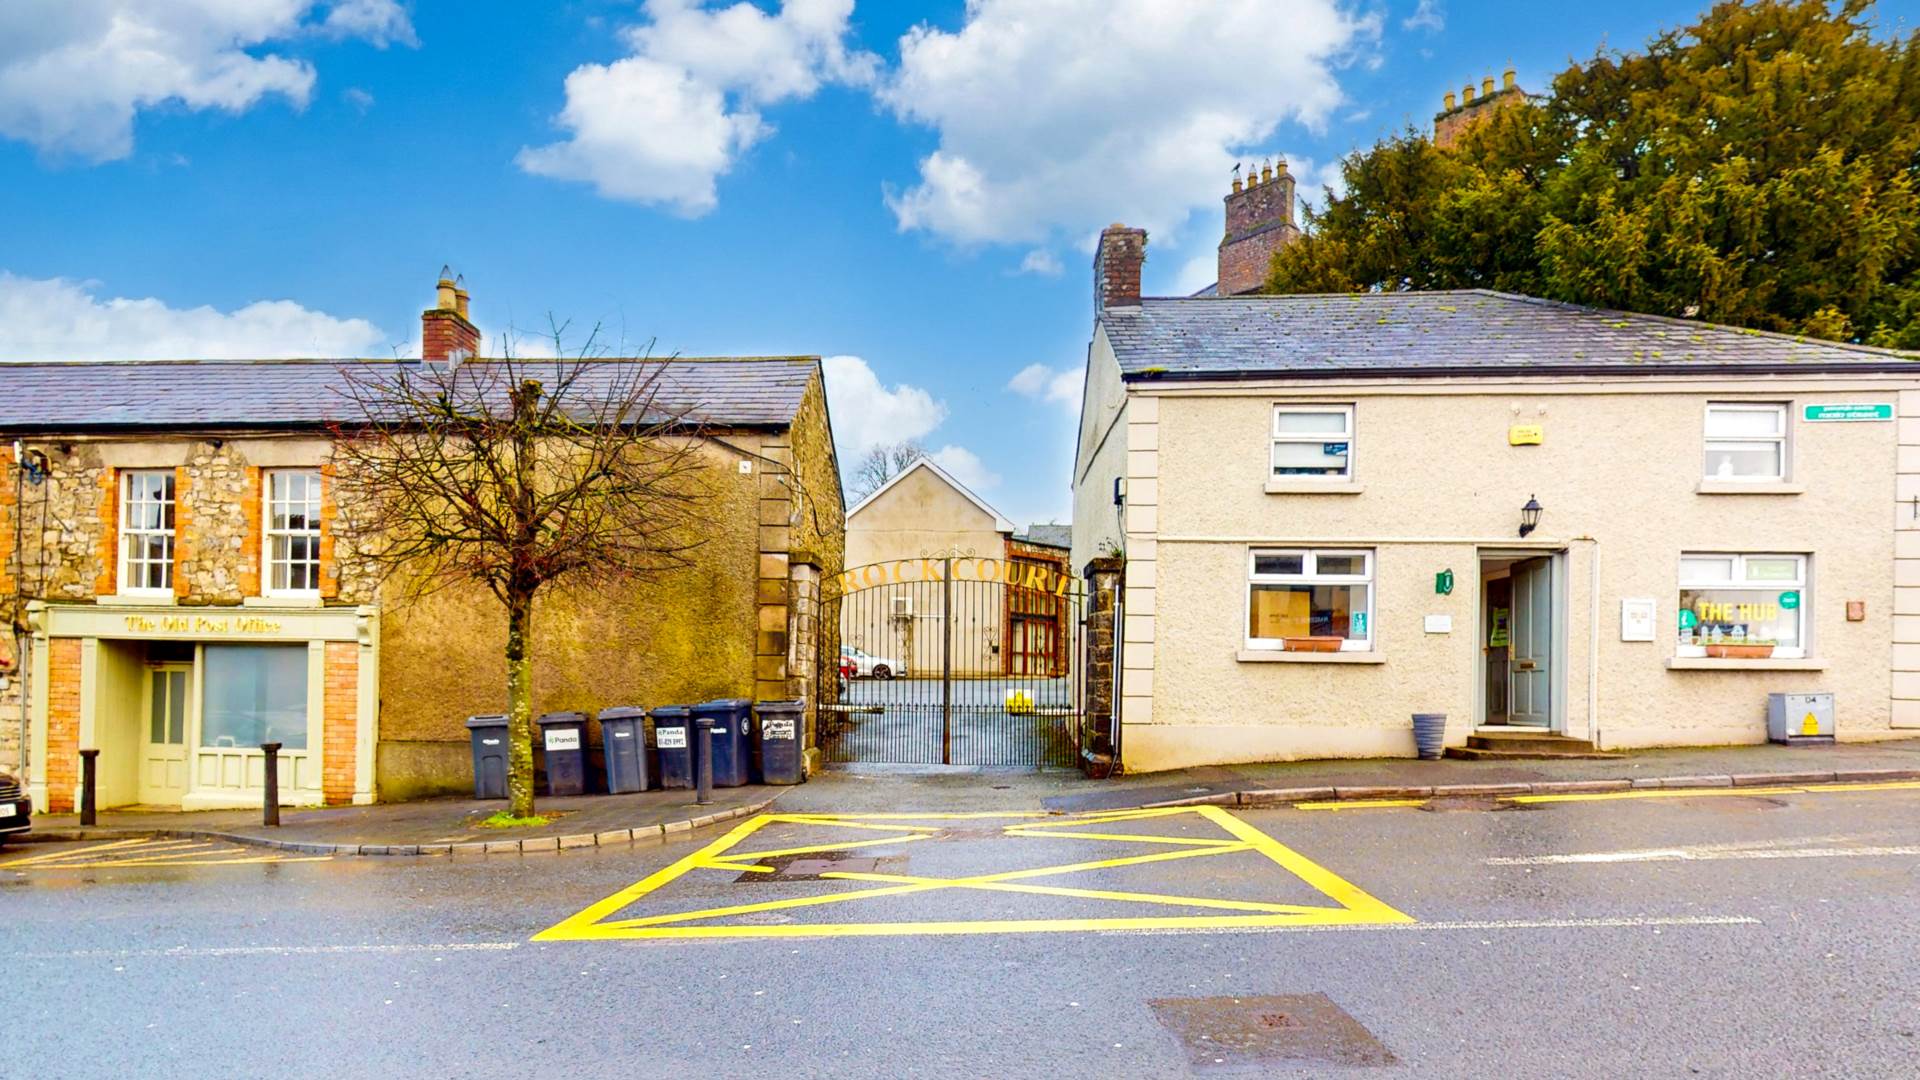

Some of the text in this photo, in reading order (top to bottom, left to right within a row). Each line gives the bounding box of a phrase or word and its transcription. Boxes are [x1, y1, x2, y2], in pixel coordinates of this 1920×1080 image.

[1698, 602, 1777, 621] THE HUB
[125, 614, 281, 633] The Old Post Office
[554, 736, 577, 744] Panda
